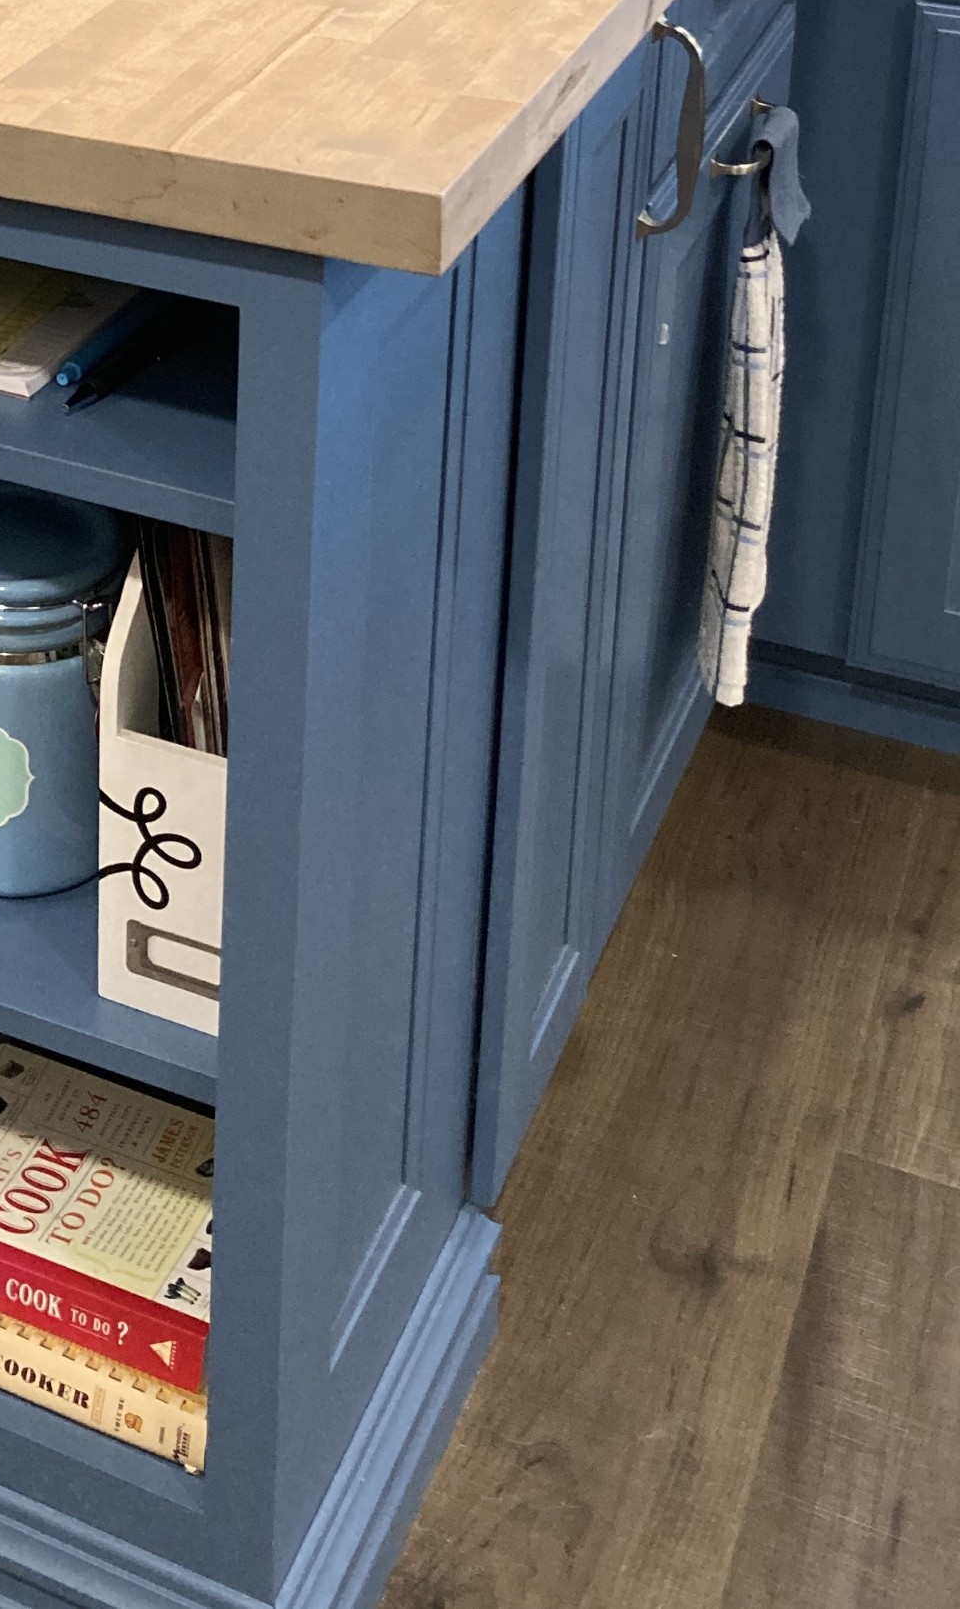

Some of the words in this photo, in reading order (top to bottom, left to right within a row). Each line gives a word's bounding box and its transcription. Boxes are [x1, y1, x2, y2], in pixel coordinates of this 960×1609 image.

[75, 1092, 108, 1133] 484
[22, 1133, 36, 1144] A
[151, 1118, 185, 1163] JAMES
[45, 1211, 85, 1246] TO
[74, 1156, 126, 1210] DO?
[5, 1277, 62, 1322] COOK
[71, 1307, 87, 1326] TO
[93, 1317, 111, 1336] DO
